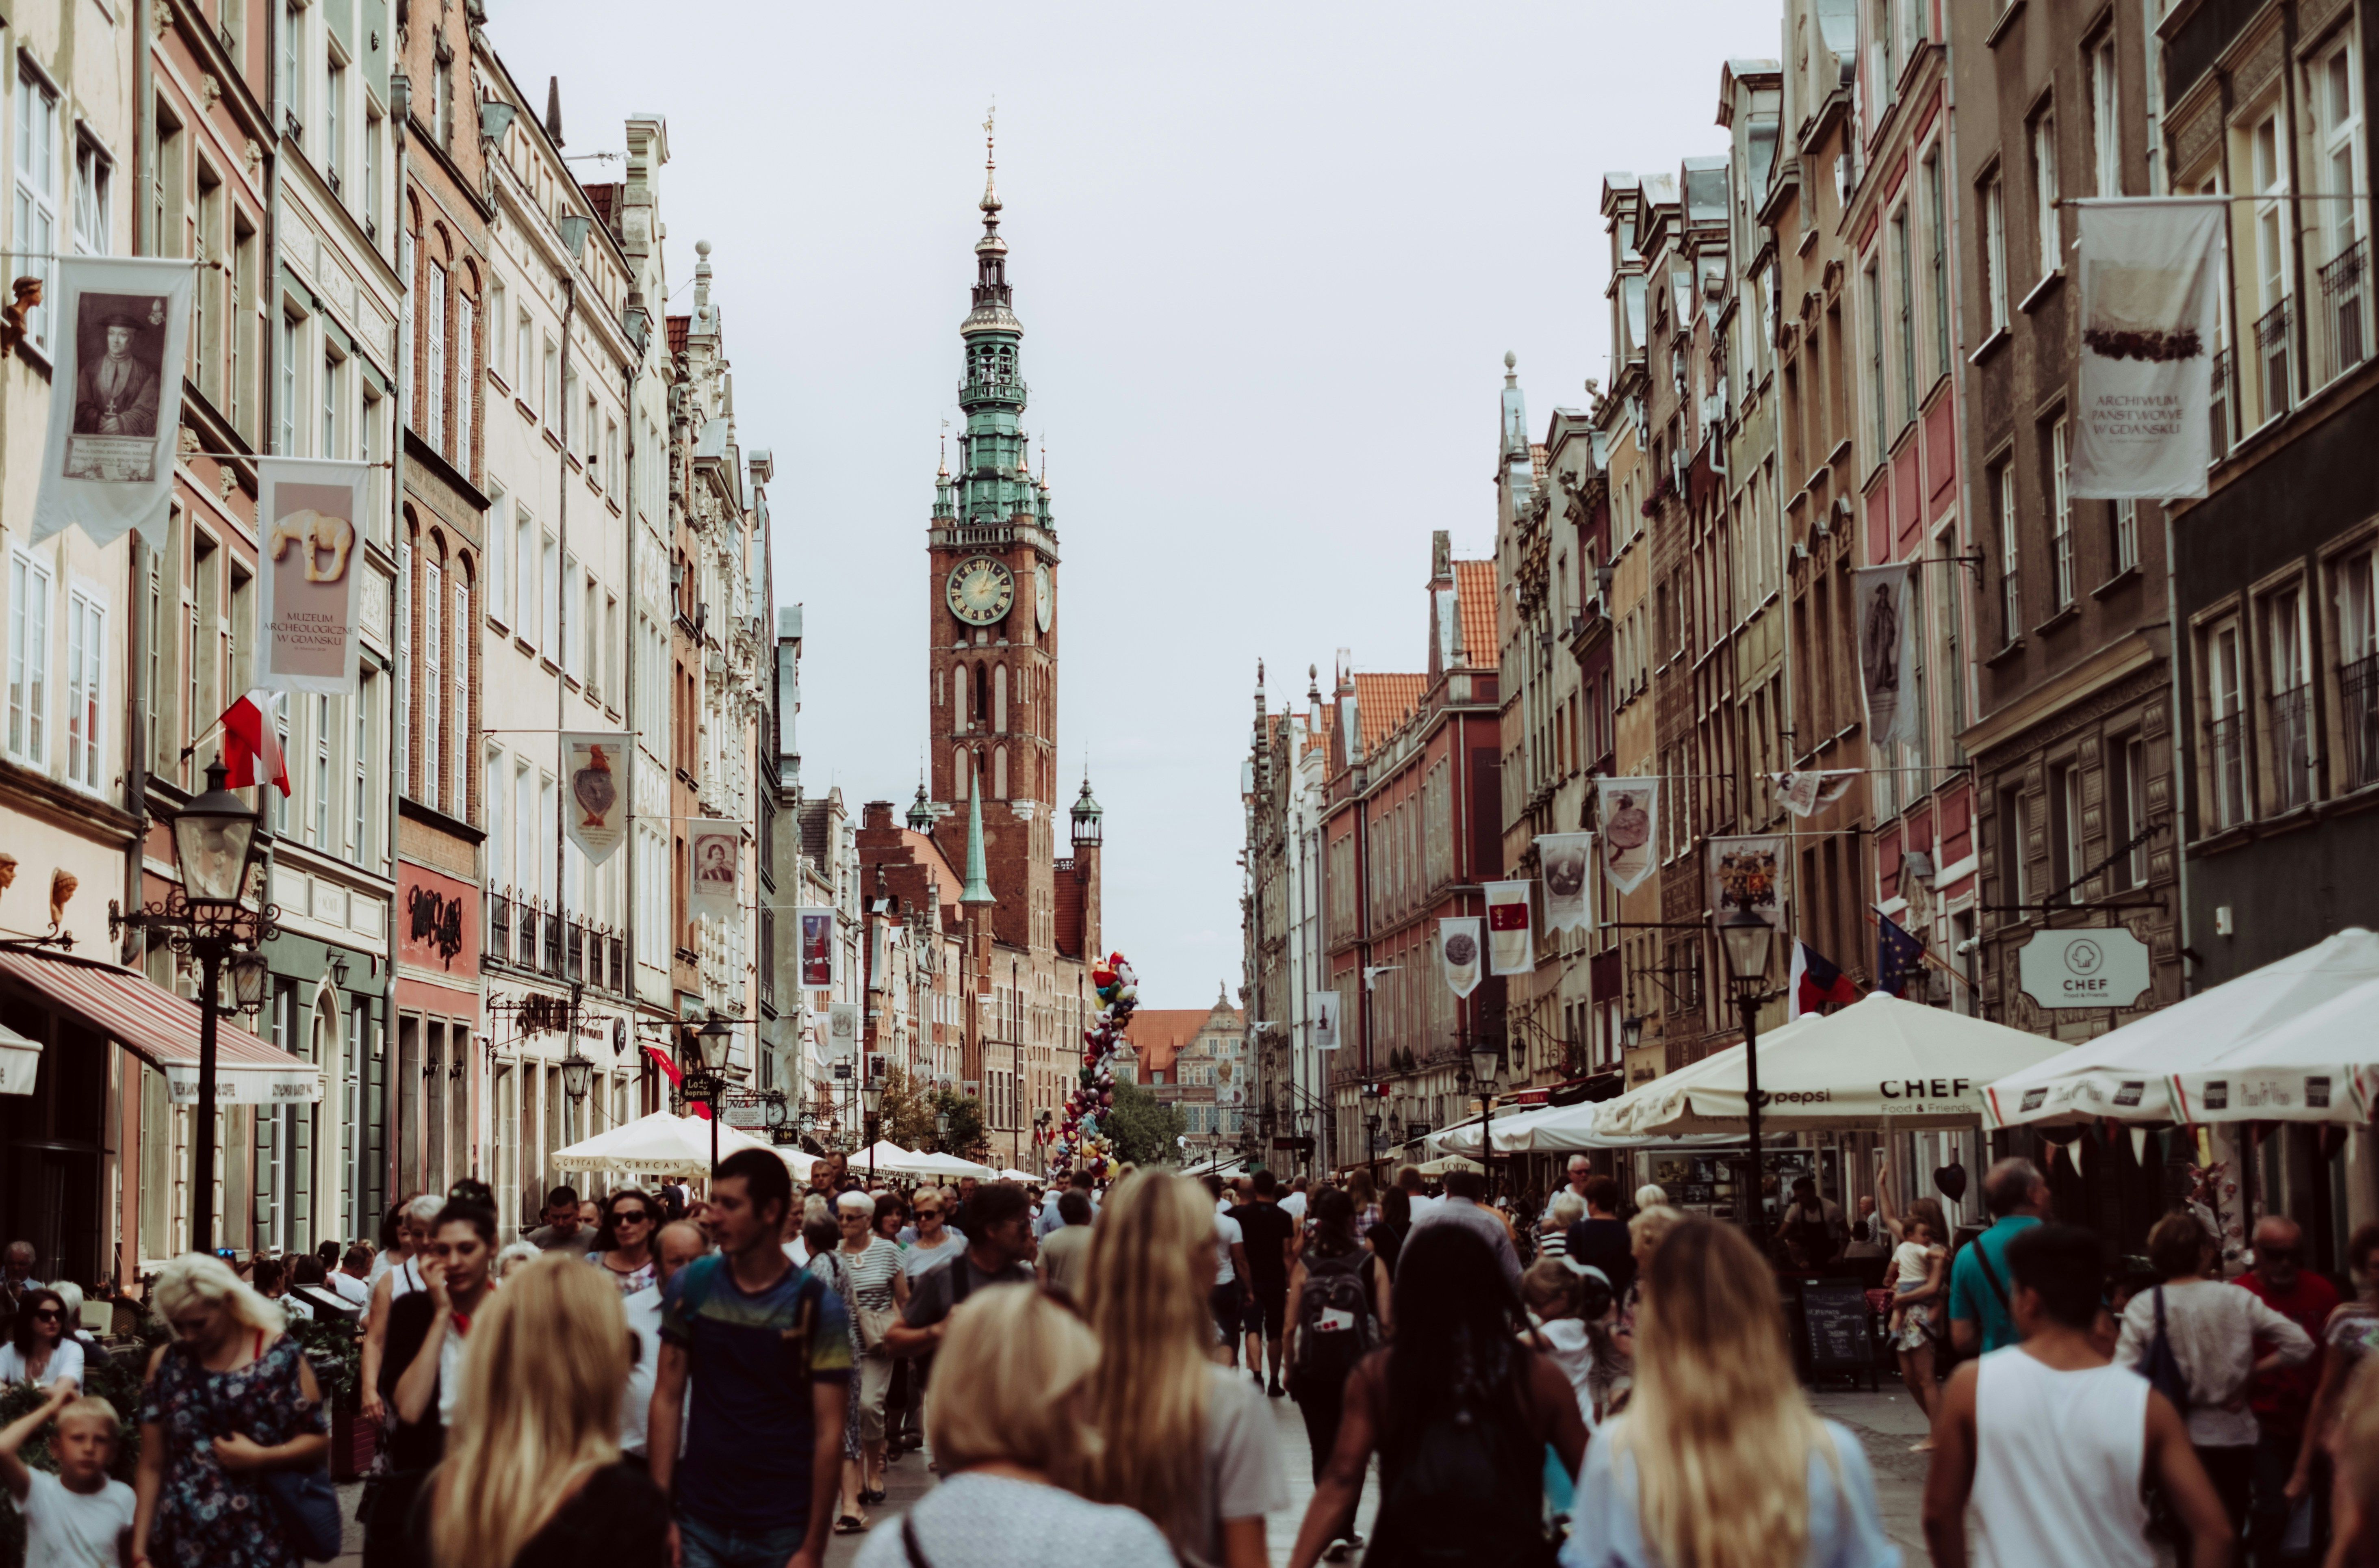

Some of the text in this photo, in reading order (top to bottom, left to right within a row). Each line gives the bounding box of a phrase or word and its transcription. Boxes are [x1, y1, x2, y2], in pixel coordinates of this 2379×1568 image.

[2096, 396, 2179, 406] ARCHIWUM
[2092, 408, 2183, 420] PAŃSTWOWE
[2093, 424, 2181, 435] W GDAŃSKU
[287, 613, 333, 622] MUZEUM
[263, 623, 353, 635] ARCHEOLOGICZNE
[277, 634, 341, 645] W GDAŃSKU
[2063, 979, 2107, 990] CHEF
[685, 1089, 711, 1097] Soprano
[1880, 1078, 1970, 1098] CHEF
[1774, 1088, 1830, 1107] pepsi
[1880, 1102, 1972, 1114] Food & Friends
[563, 1158, 597, 1167] GRYCAN
[625, 1160, 681, 1170] GRYCAN
[1442, 1162, 1470, 1172] LODY
